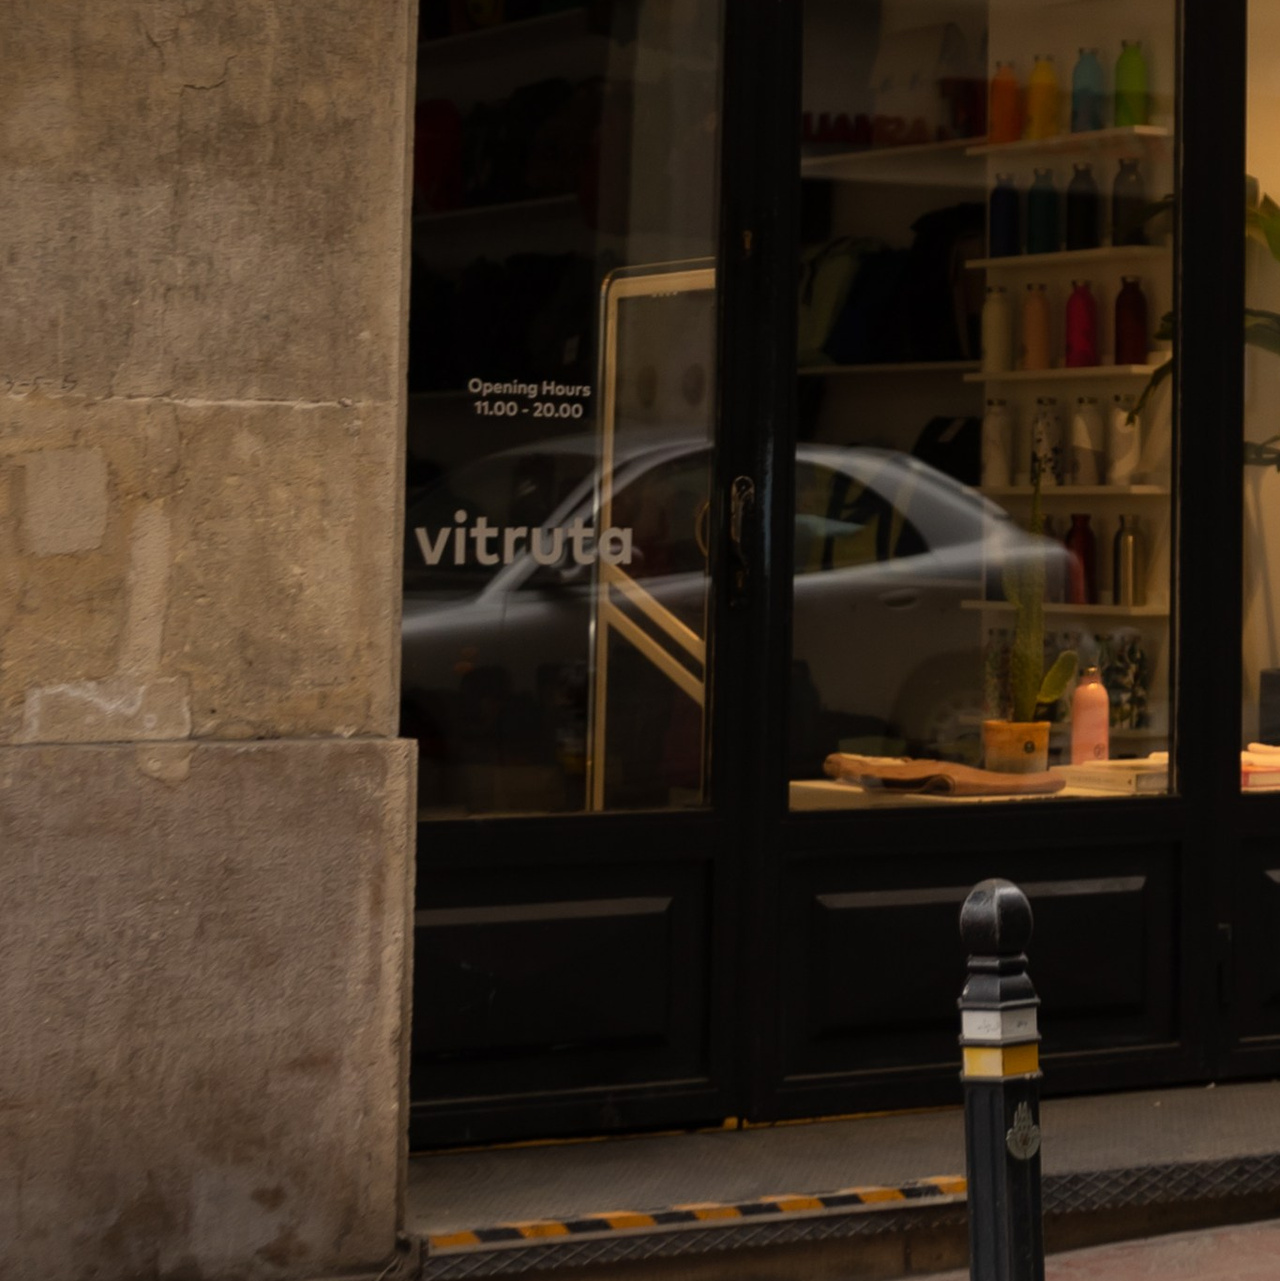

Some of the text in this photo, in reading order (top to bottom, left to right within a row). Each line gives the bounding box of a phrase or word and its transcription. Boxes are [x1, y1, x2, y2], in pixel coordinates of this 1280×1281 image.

[468, 377, 592, 399] Opening Hours
[474, 401, 518, 417] 11.00
[533, 402, 584, 418] 20.00
[414, 508, 634, 566] vitruta
